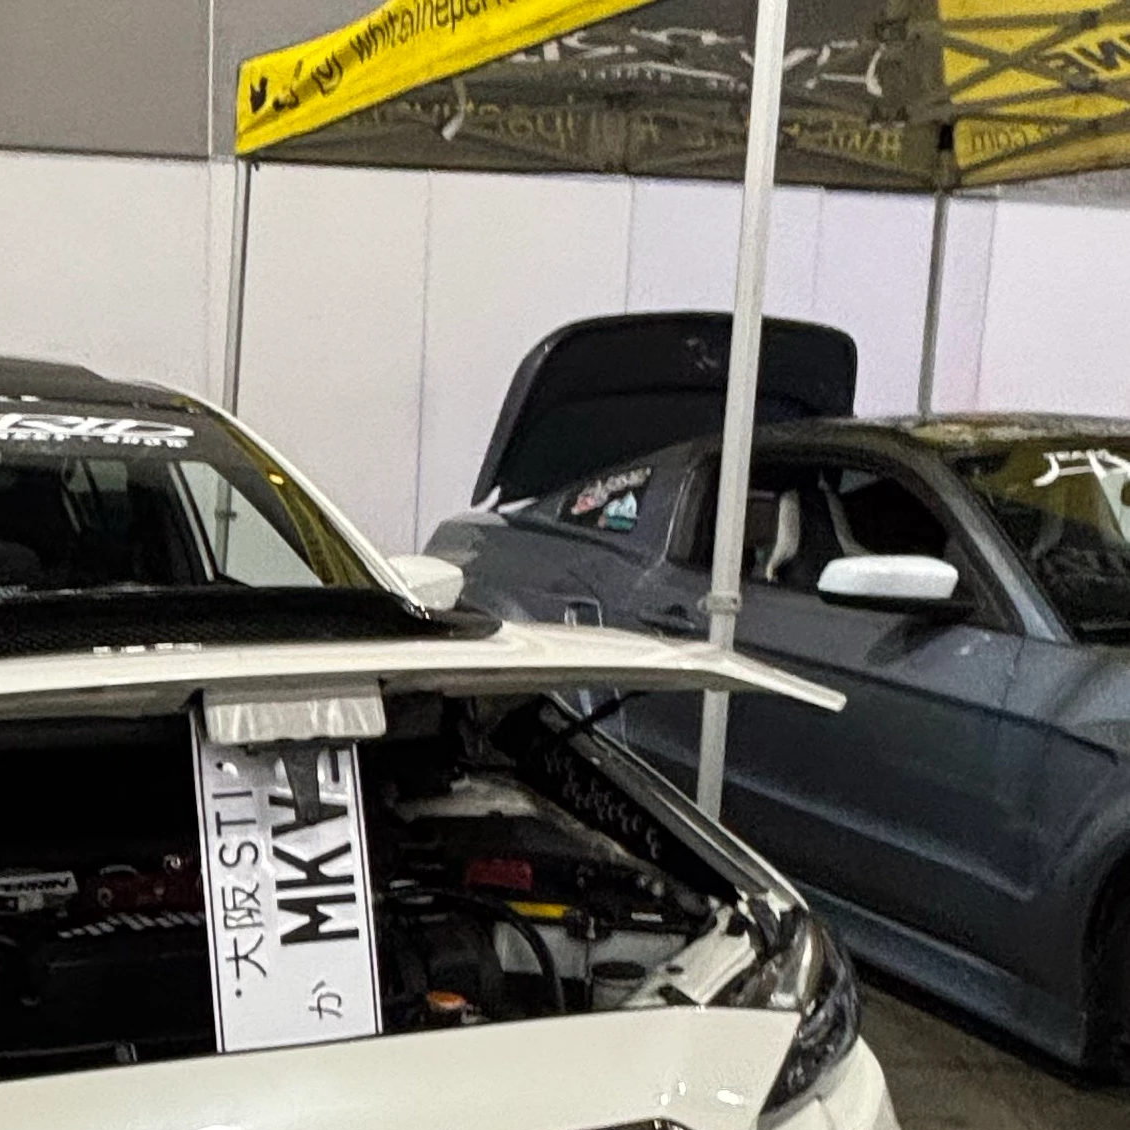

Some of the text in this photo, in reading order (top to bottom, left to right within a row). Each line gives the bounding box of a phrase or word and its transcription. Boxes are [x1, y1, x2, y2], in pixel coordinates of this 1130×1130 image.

[211, 789, 267, 979] 大阪 STI
[268, 748, 360, 946] MKV
[307, 980, 343, 1021] か
